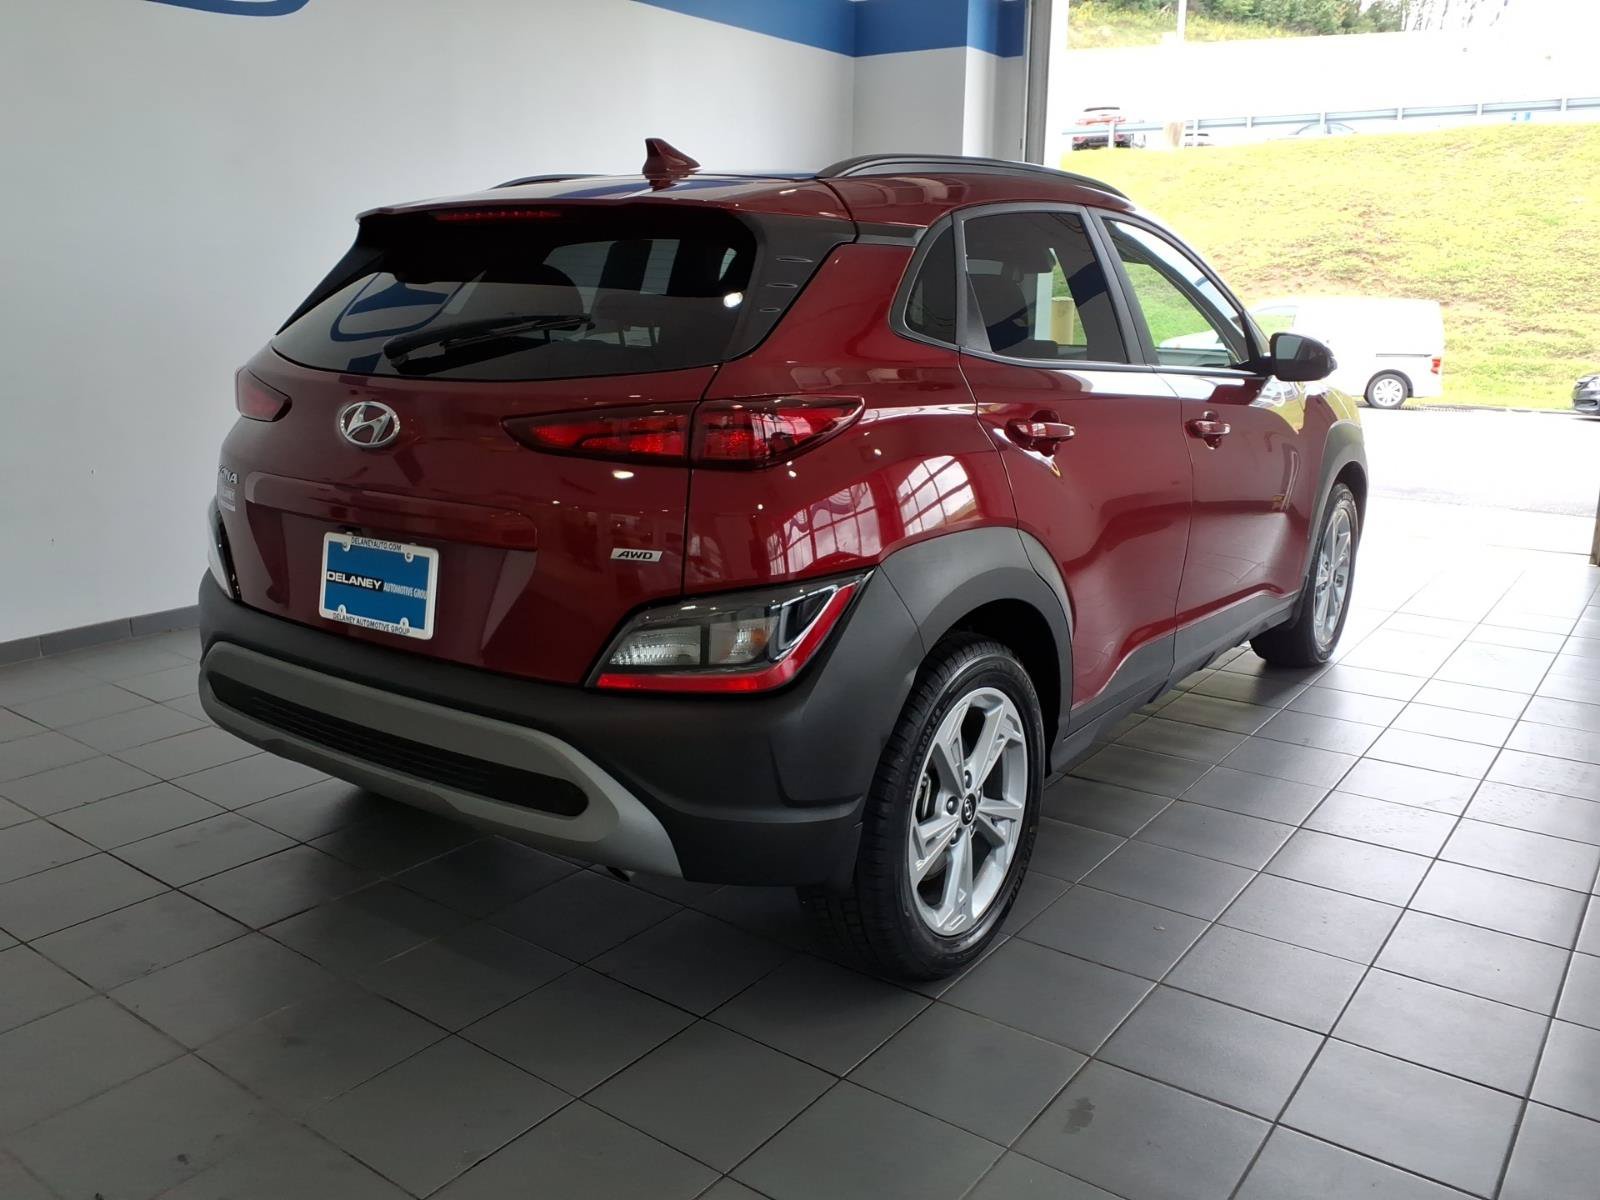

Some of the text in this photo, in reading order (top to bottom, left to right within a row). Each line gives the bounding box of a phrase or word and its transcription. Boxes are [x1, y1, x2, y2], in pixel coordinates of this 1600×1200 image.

[351, 537, 402, 551] DELANEYAUTO.COM
[616, 550, 653, 559] AWD
[327, 571, 382, 590] DELANEY
[383, 582, 413, 597] AUTOMOTIVE
[333, 613, 411, 635] DELANEY AUTOMOTIVE GROUP
